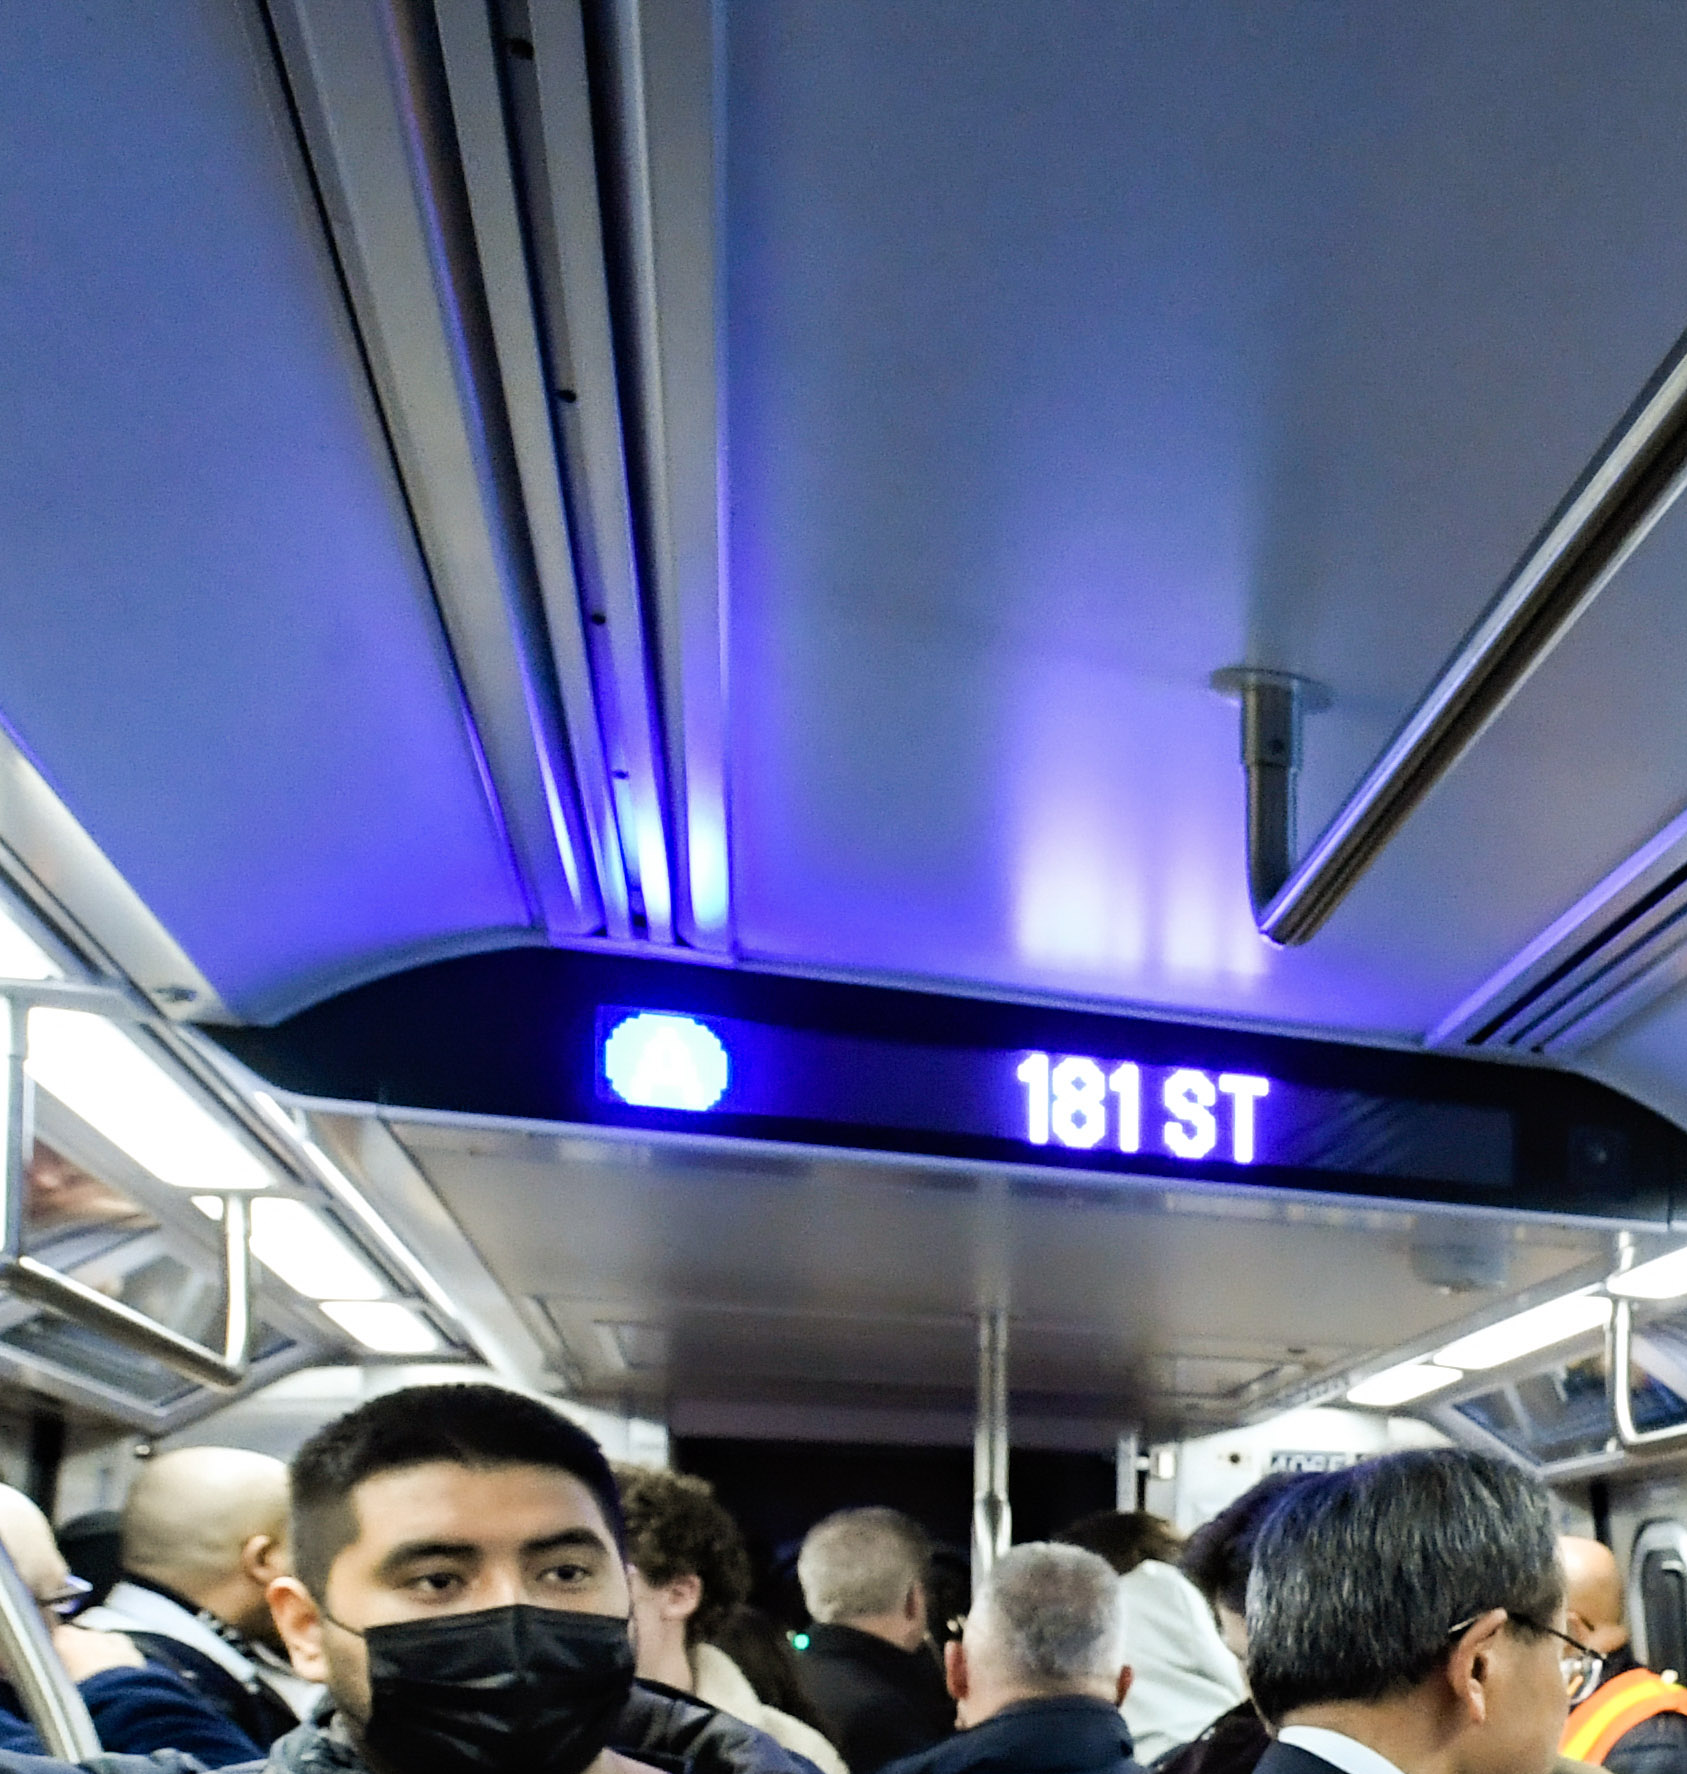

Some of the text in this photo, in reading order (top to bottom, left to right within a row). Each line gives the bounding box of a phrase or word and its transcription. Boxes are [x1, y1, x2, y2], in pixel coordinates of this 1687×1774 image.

[630, 1026, 705, 1106] A
[1017, 1052, 1269, 1164] 181 ST
